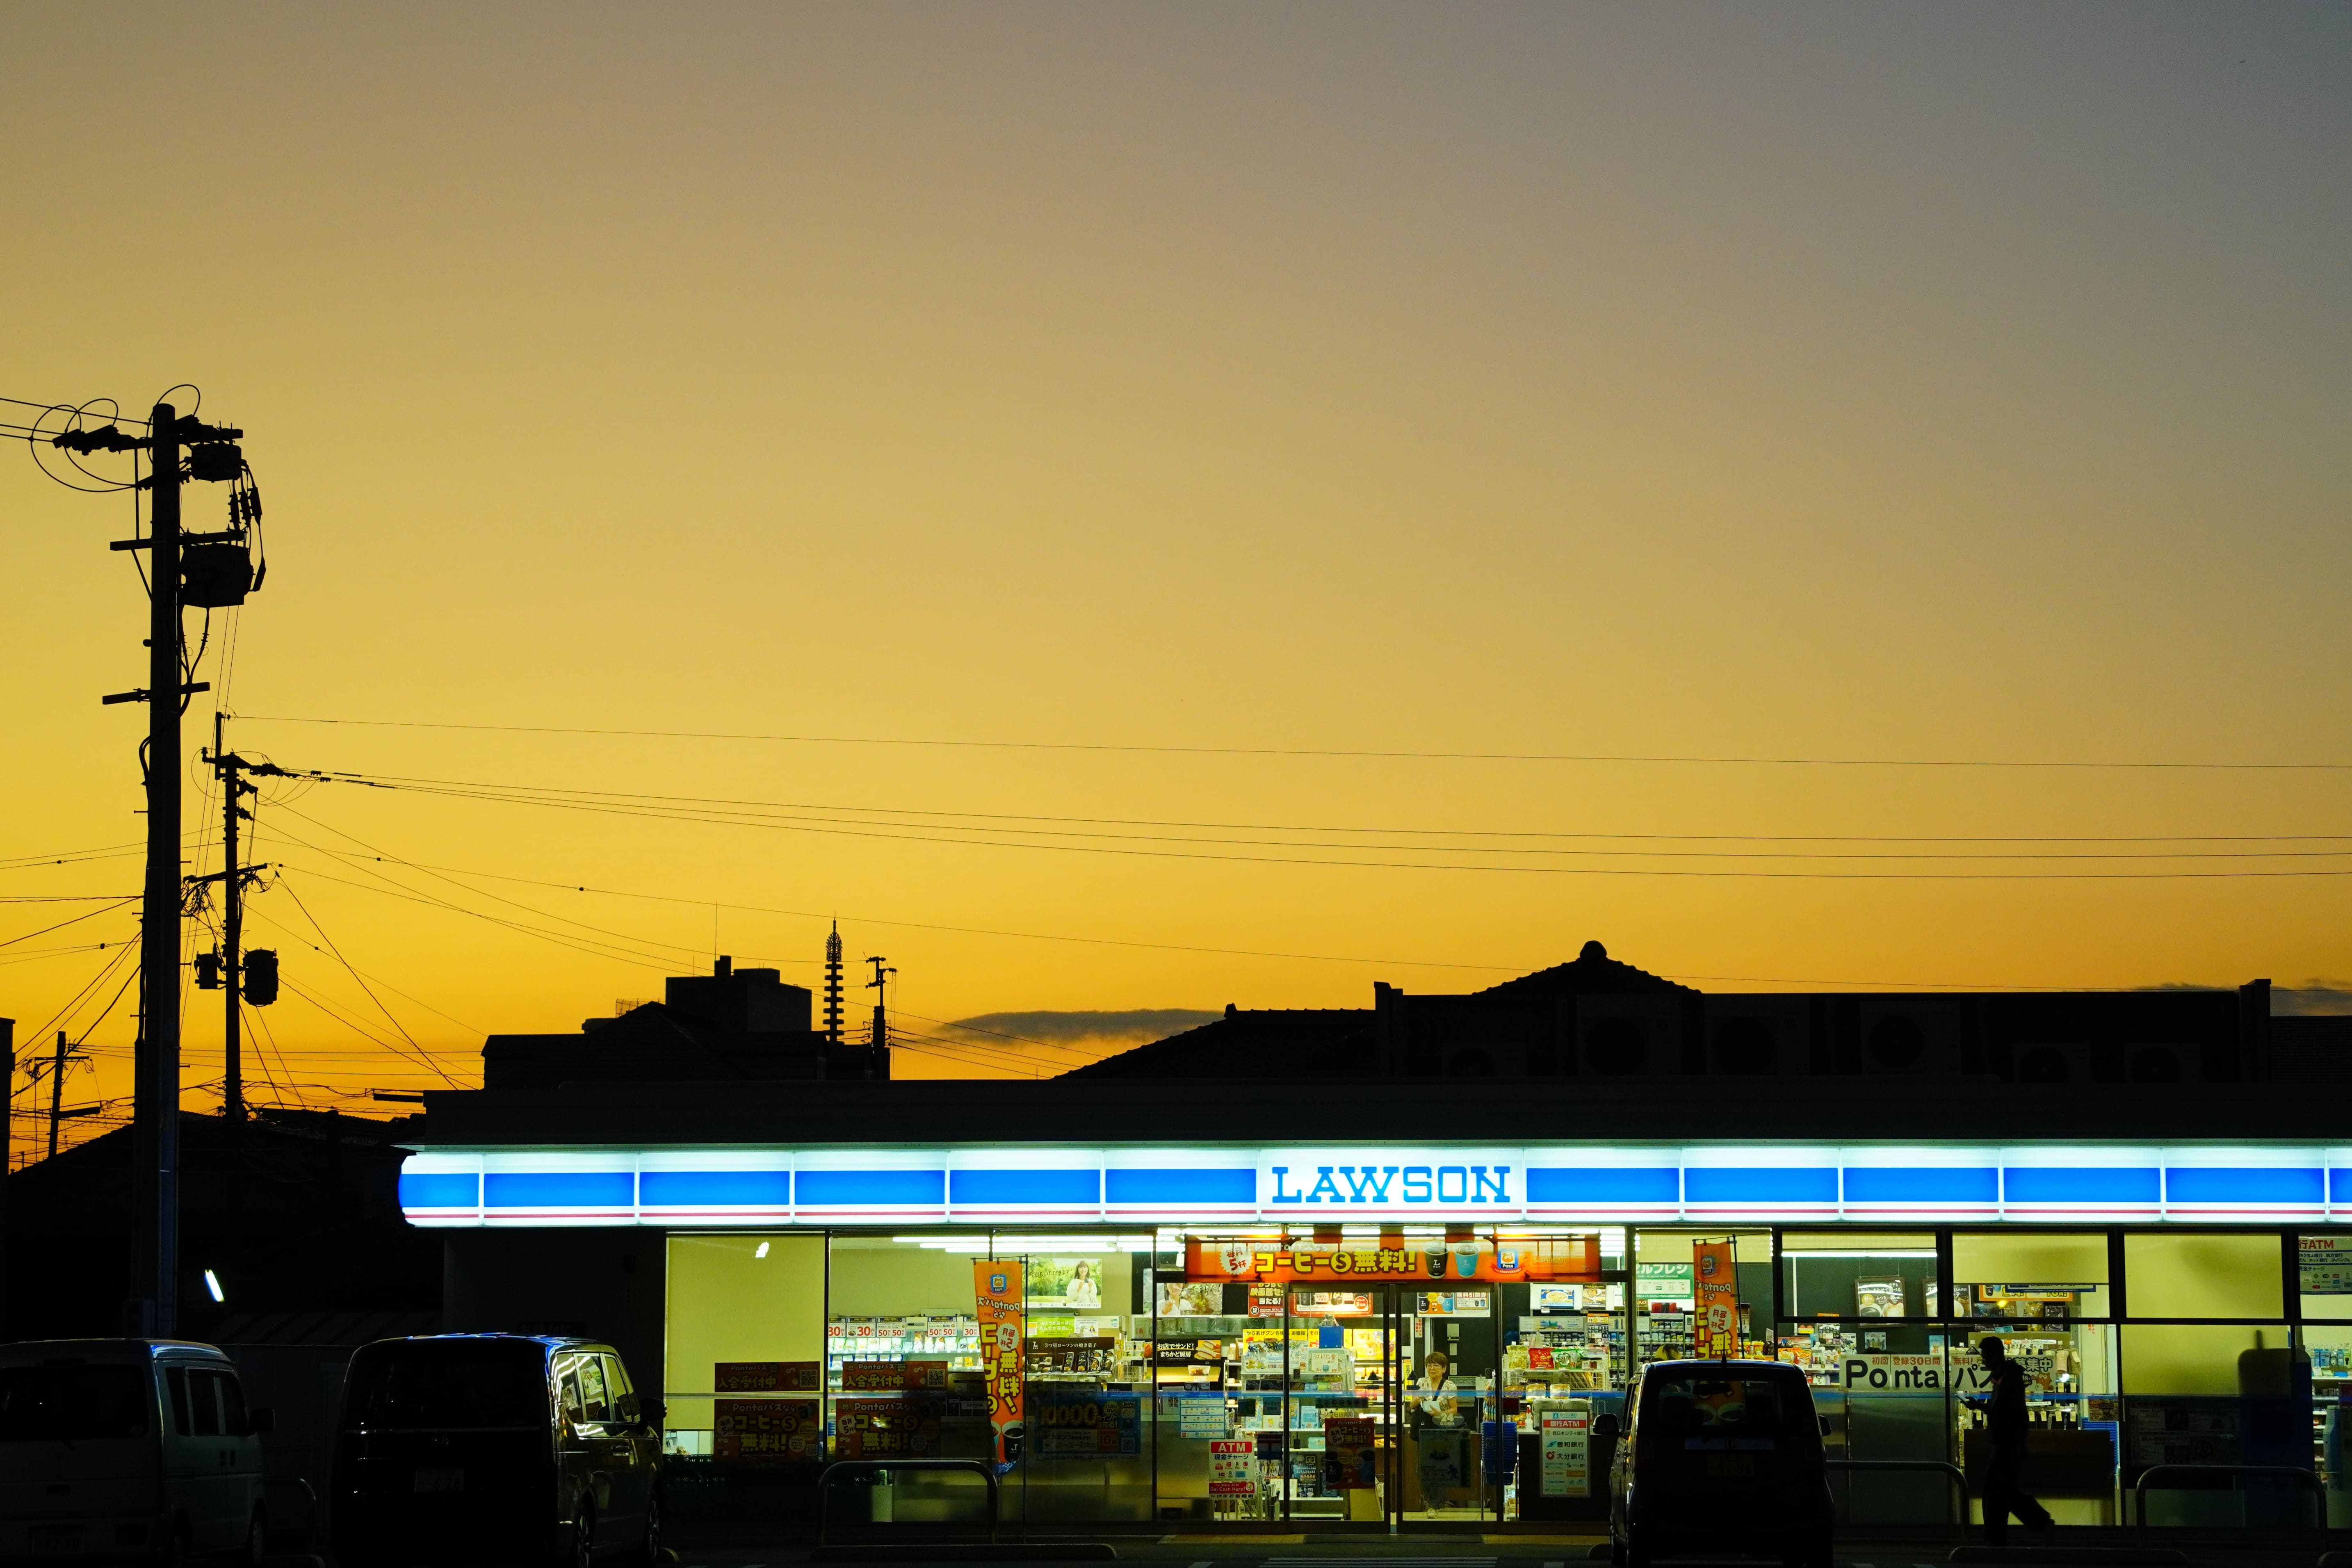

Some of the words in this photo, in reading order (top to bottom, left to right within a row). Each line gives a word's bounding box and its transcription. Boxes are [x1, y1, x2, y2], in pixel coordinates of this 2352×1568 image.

[1272, 1166, 1510, 1203] LAWSON
[1226, 1246, 1243, 1257] 毎月
[1229, 1258, 1247, 1271] 5杯
[1872, 1357, 1888, 1365] 初回
[1893, 1357, 1940, 1365] 登録30日間
[1953, 1357, 1973, 1365] 無料!
[718, 1375, 777, 1388] 入会受付中
[845, 1374, 904, 1387] 入会受付中
[732, 1402, 796, 1412] Pontaパスなら
[854, 1401, 917, 1411] Pontaパスなら
[1440, 1413, 1454, 1422] 24
[740, 1432, 787, 1452] 無料!
[862, 1431, 909, 1451] 無料!
[1344, 1435, 1368, 1444] 無料!
[1218, 1442, 1246, 1452] ATM
